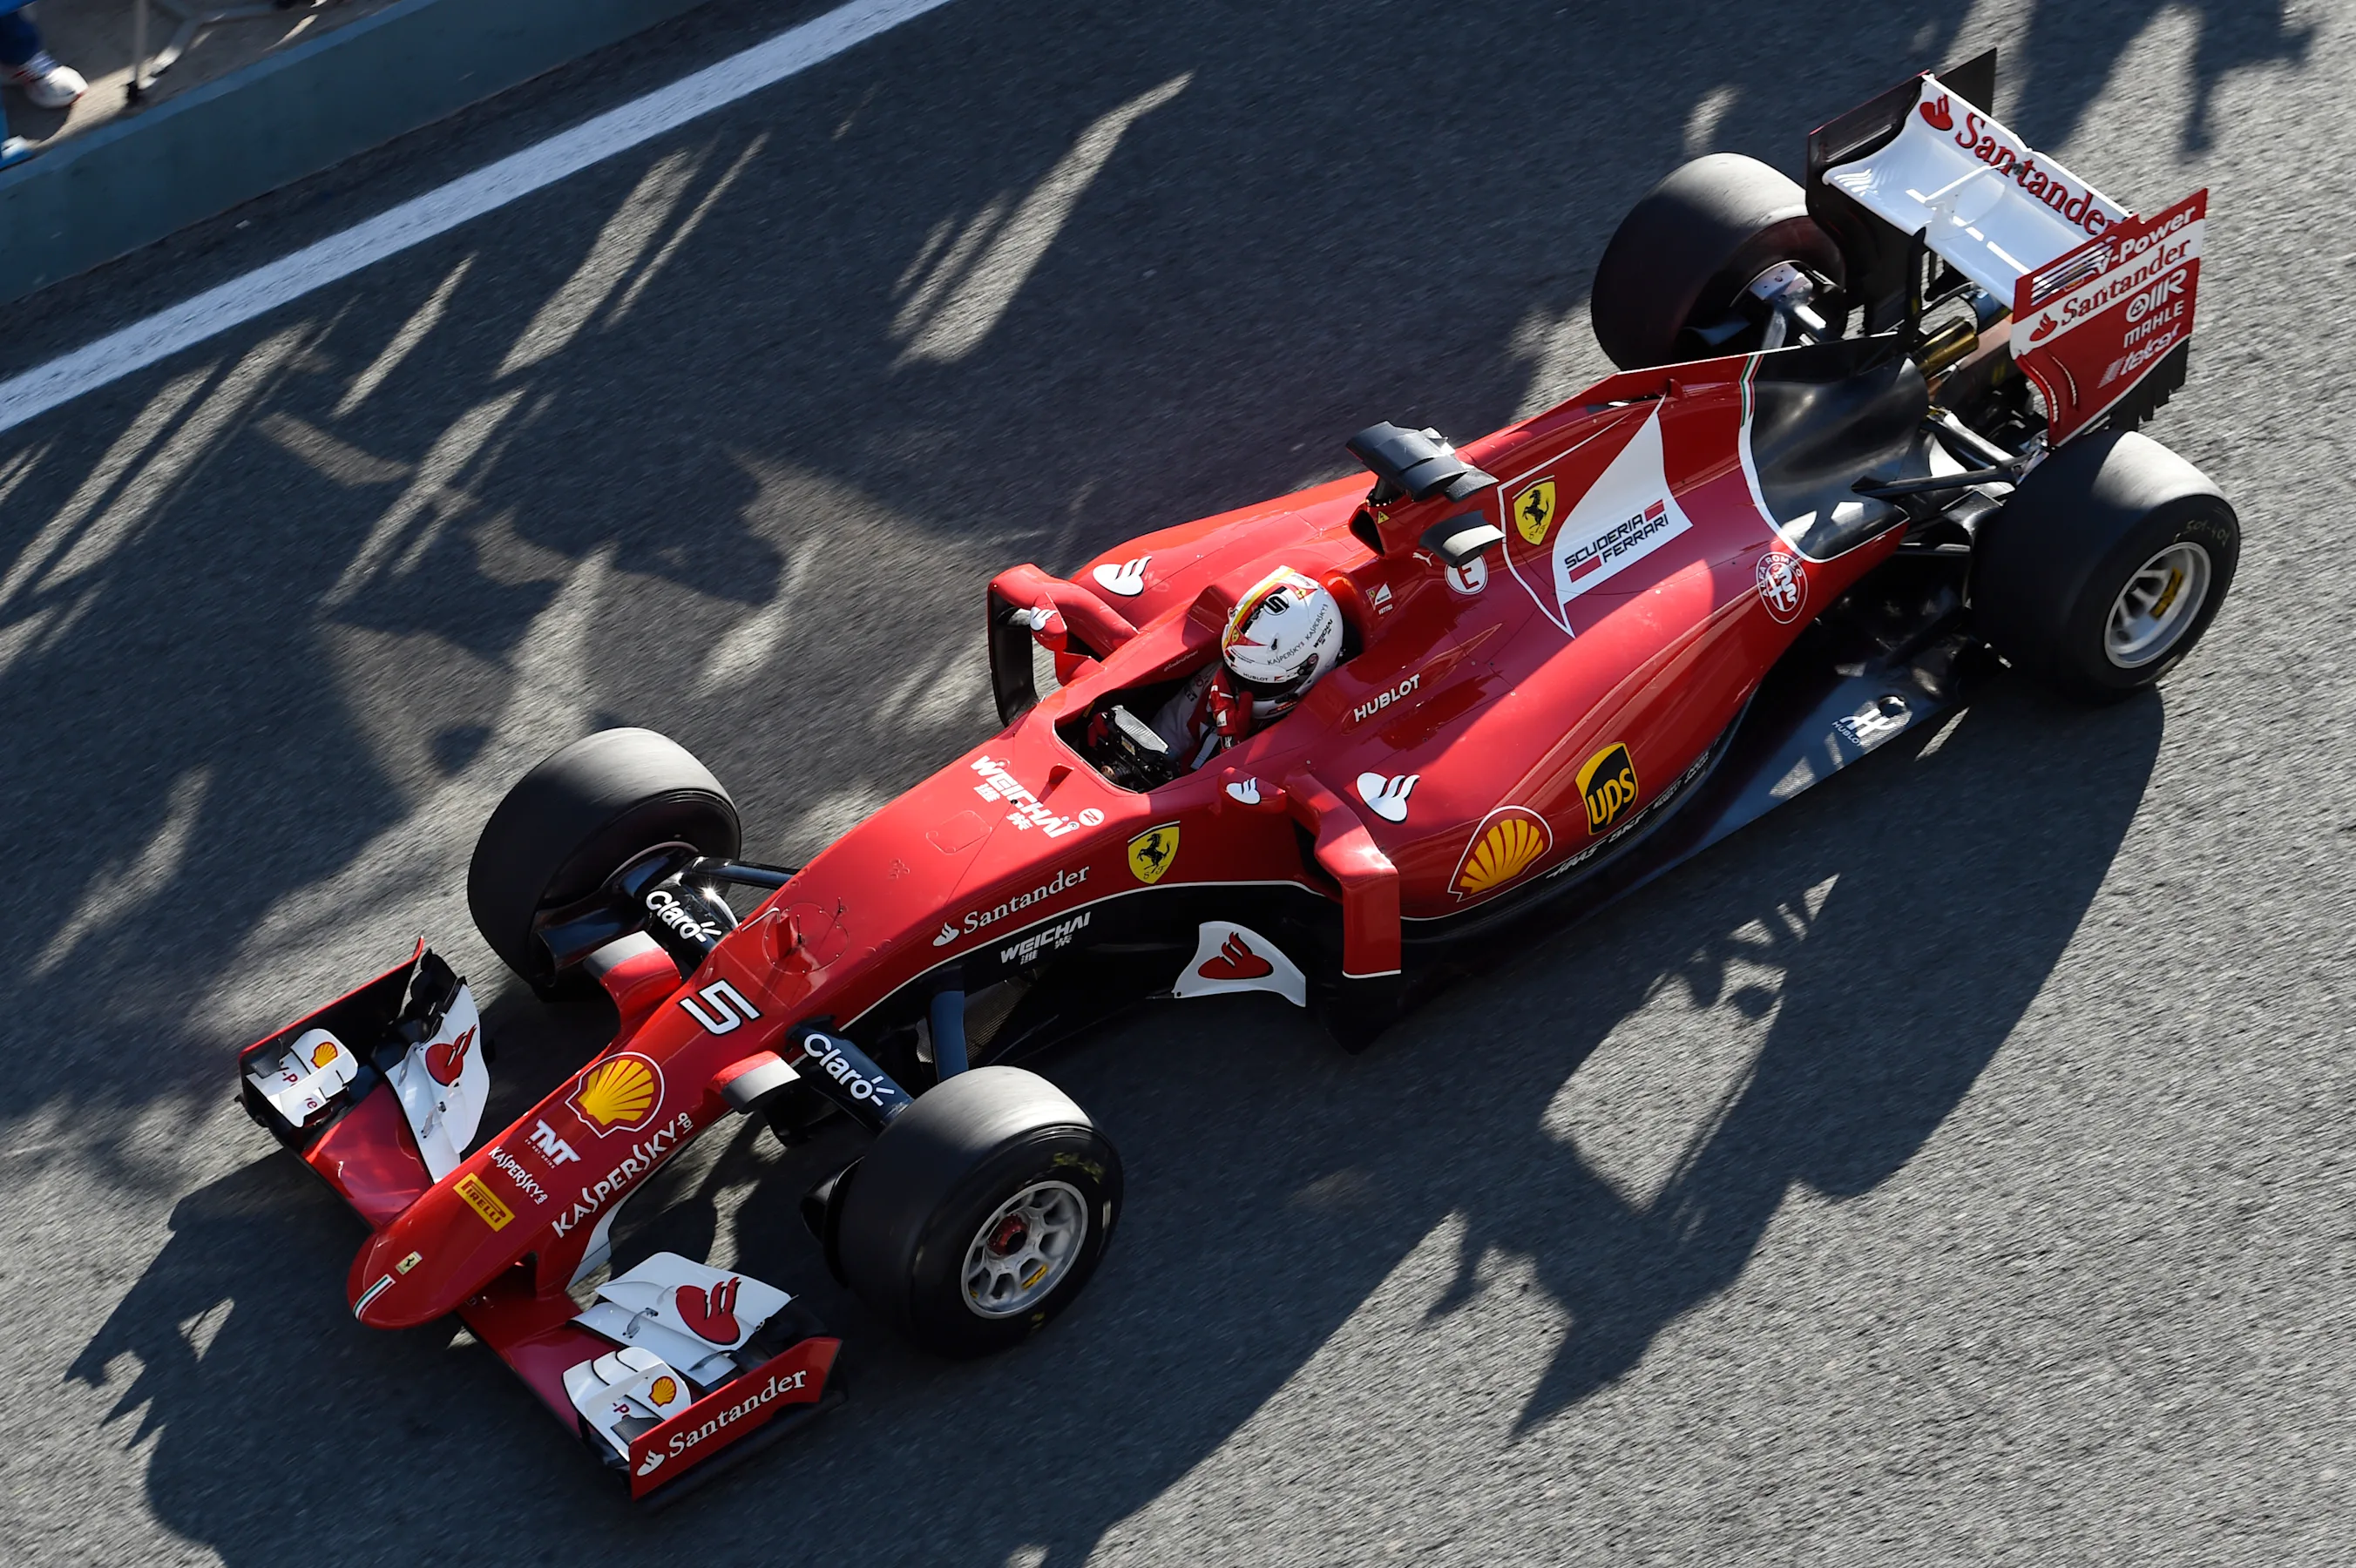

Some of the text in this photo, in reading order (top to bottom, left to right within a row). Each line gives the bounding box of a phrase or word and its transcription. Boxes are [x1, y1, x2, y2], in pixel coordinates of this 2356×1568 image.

[2062, 240, 2190, 328] Santander
[2123, 300, 2184, 348] MAHLE
[1564, 514, 1645, 568] SCUDERIA
[1603, 514, 1669, 563] FERRARI
[1457, 566, 1480, 590] E
[1765, 555, 1803, 578] ROMEO
[1265, 595, 1290, 614] 5
[1242, 672, 1269, 682] HUBLOT
[1267, 643, 1302, 666] KASPERSKY
[1353, 673, 1421, 722] HUBLOT
[1832, 720, 1862, 747] HUBLOT
[970, 754, 1074, 839] WEICHAI
[646, 890, 704, 941] Claro
[963, 866, 1090, 935] Santander
[1000, 911, 1092, 964] WEICHAI
[677, 977, 762, 1035] 5
[803, 1033, 877, 1104] Claro
[529, 1119, 582, 1166] TNT
[488, 1146, 545, 1198] KASPERSKY
[551, 1119, 679, 1239] KASPERSKY
[461, 1179, 507, 1224] PIRELLI
[668, 1369, 808, 1459] Santander
